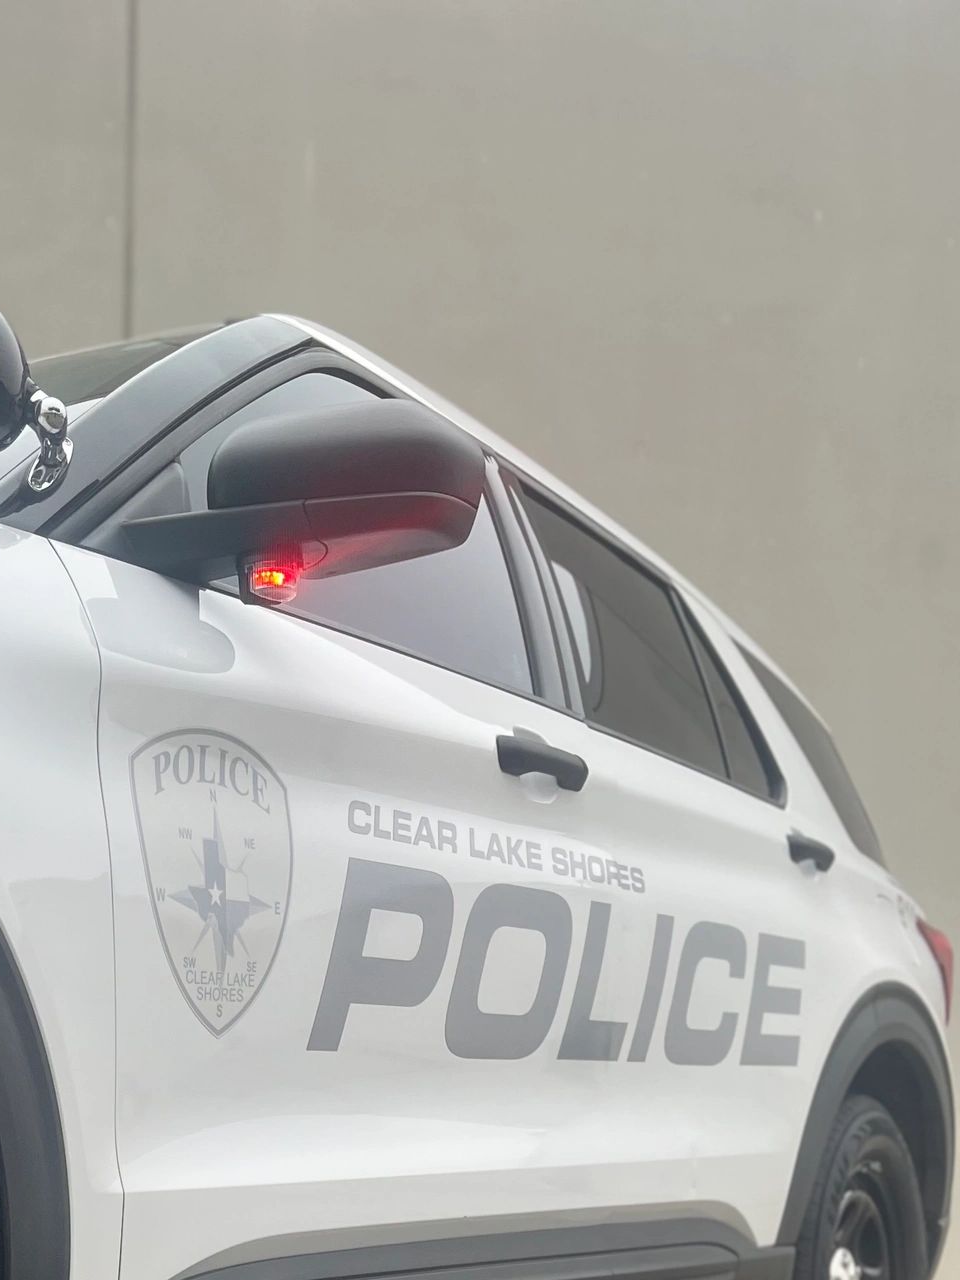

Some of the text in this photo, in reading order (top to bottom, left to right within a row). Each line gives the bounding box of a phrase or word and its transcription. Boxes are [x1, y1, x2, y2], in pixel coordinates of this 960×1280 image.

[152, 744, 271, 814] POLICE
[209, 789, 217, 802] N
[178, 828, 192, 840] NW
[244, 838, 256, 850] NE
[347, 799, 646, 894] CLEAR LAKE SHORES
[156, 887, 166, 901] W
[274, 902, 280, 915] E
[183, 956, 196, 969] SW
[246, 961, 257, 973] SE
[306, 857, 806, 1067] POLICE
[185, 970, 255, 988] CLEAR LAKE
[196, 986, 244, 1002] SHORES
[216, 1004, 223, 1018] S
